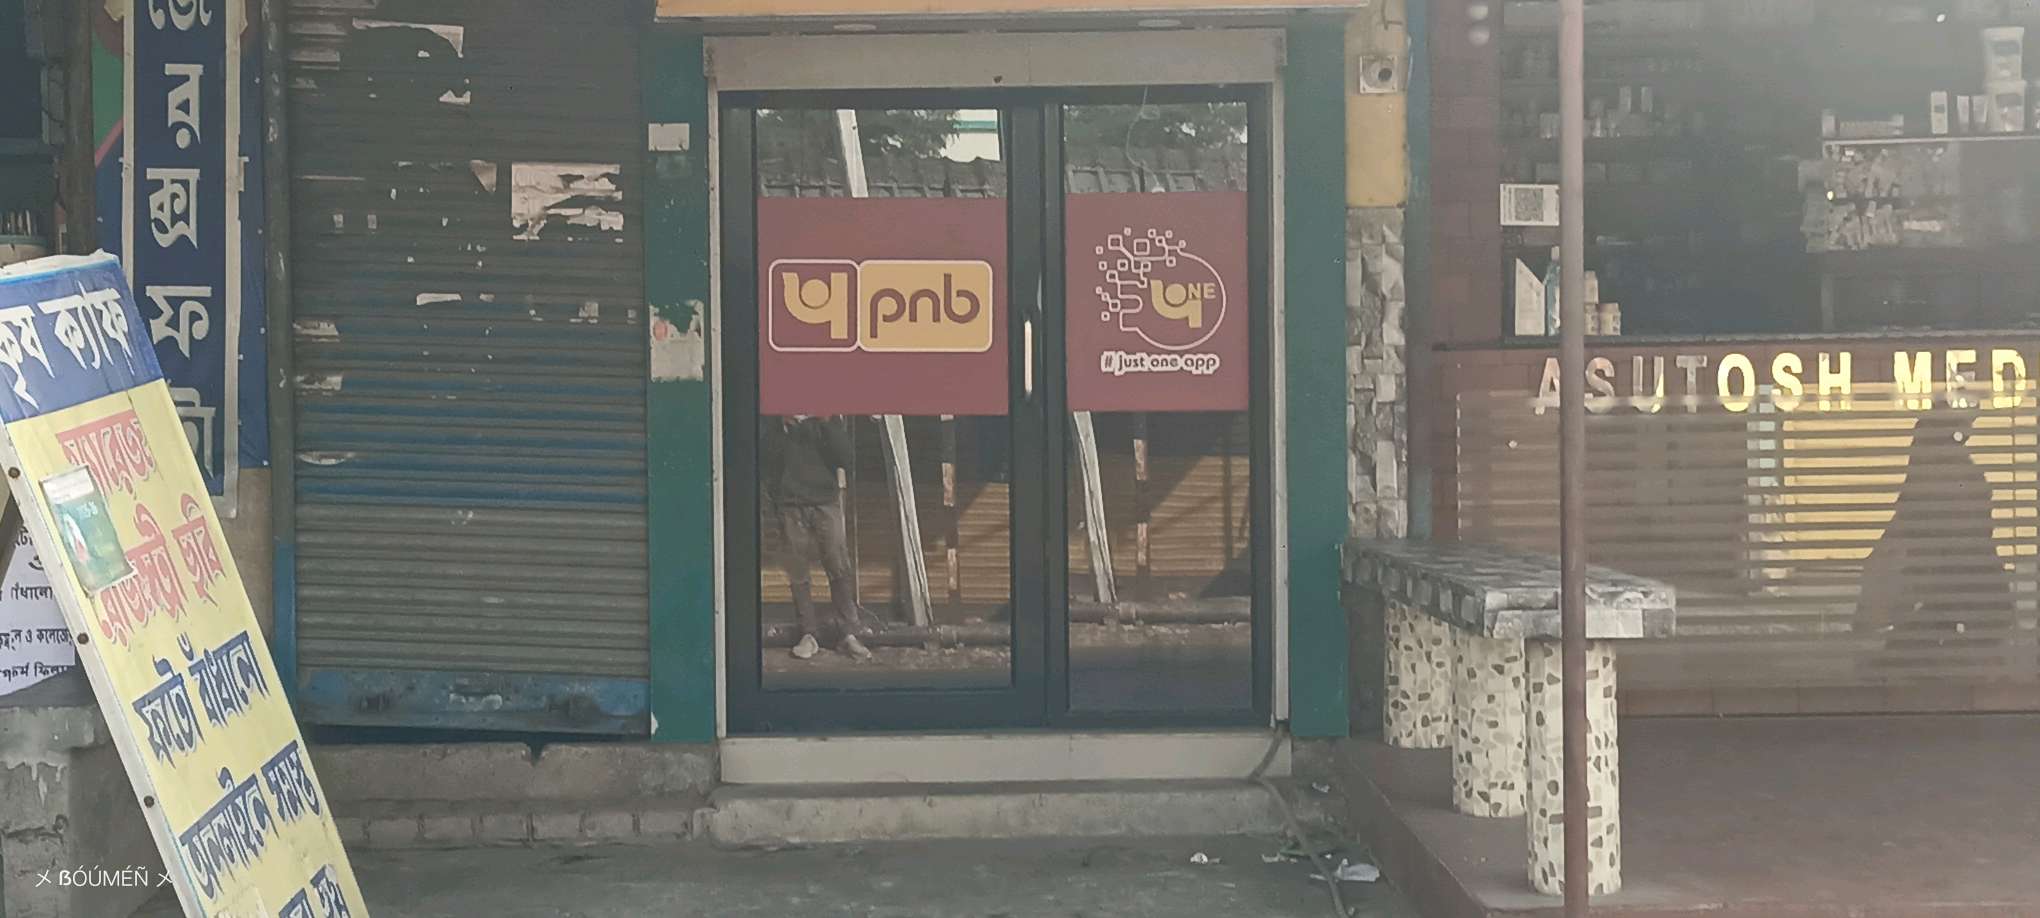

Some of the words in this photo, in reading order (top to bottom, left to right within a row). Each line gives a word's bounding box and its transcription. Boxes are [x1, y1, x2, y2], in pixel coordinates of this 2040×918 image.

[869, 273, 981, 339] pnb
[1118, 353, 1146, 372] just
[1149, 356, 1180, 369] one
[1183, 356, 1218, 372] app
[1534, 352, 1852, 414] ASUTOSH
[1894, 349, 2027, 411] MED
[132, 654, 206, 770] ফটো
[177, 630, 271, 729] বাঁধানো
[178, 766, 279, 899] অনলাইনে
